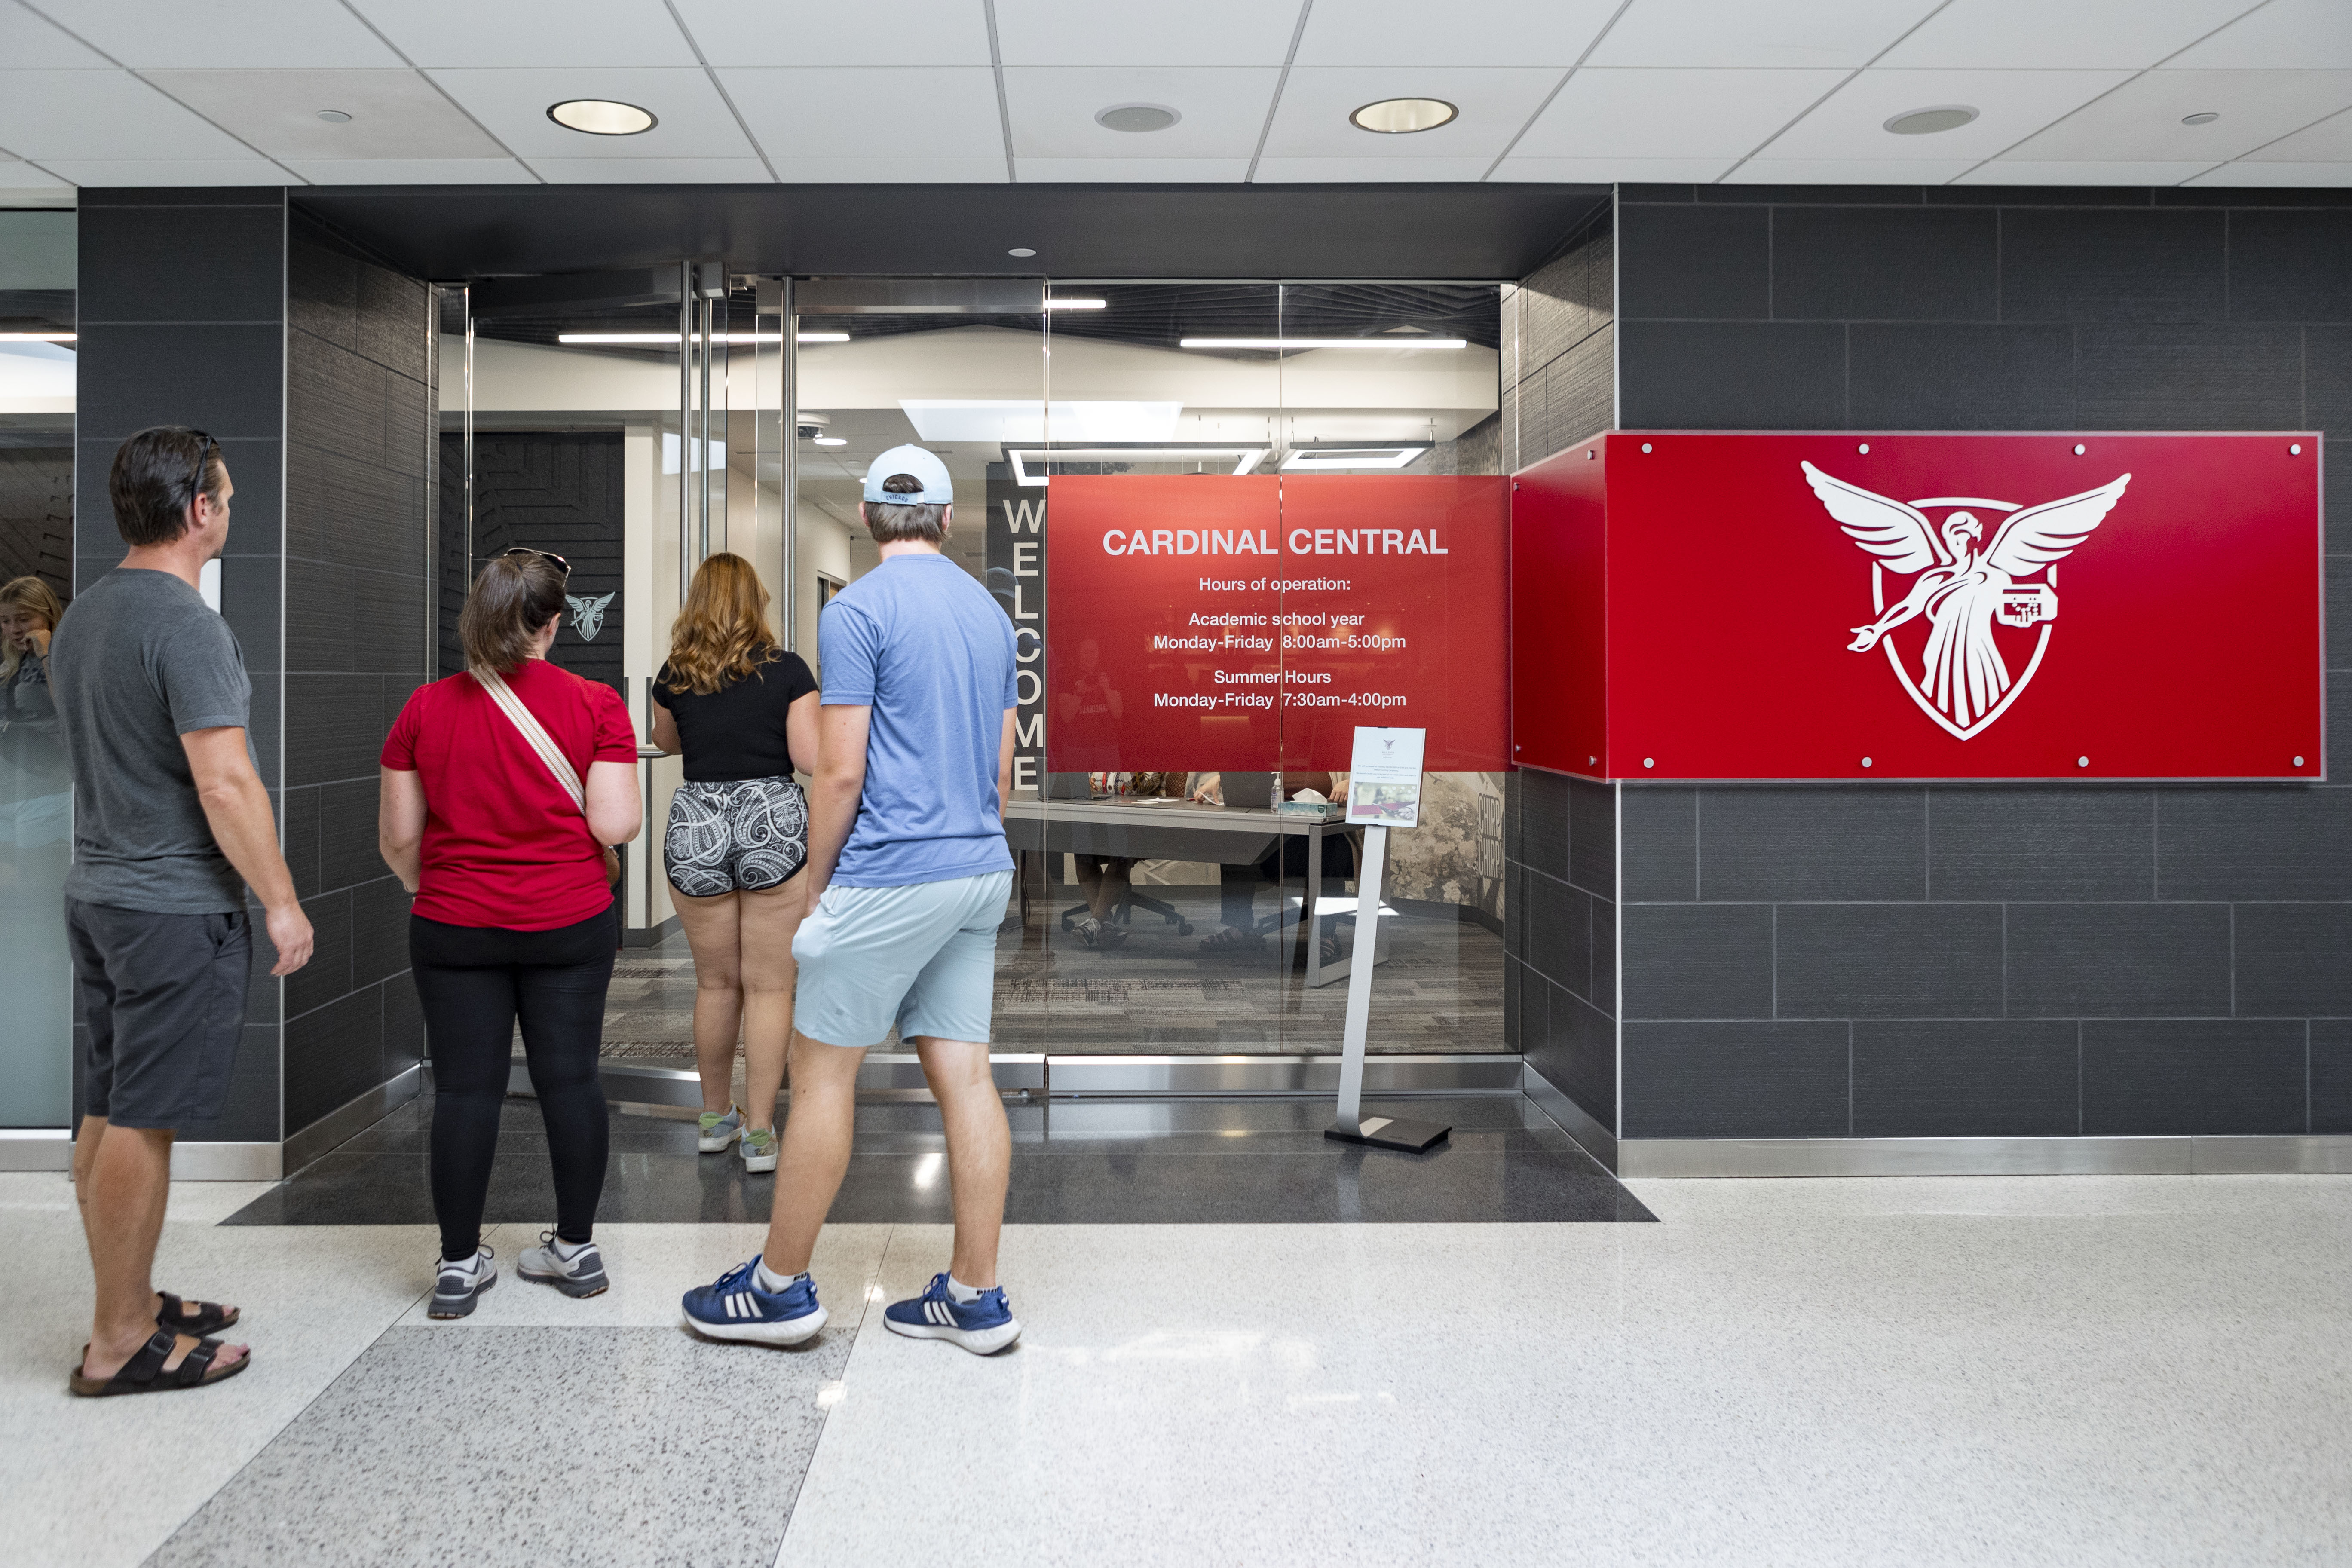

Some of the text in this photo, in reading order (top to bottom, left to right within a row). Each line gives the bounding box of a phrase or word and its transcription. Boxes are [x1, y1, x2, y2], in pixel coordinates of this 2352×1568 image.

[886, 494, 908, 502] CHICAGO
[1103, 528, 1448, 556] CARDINAL CENTRAL
[1200, 577, 1351, 593] Hours of operation:
[1188, 612, 1365, 629] Academic school year
[1003, 499, 1046, 790] WELCOME
[1154, 634, 1406, 652] Monday-Friday 8:00am-5:00pm
[1214, 670, 1331, 684] Summer Hours
[1154, 692, 1406, 710] Monday-Friday 7:30am-4:00pm
[1478, 794, 1501, 836] CHIRP
